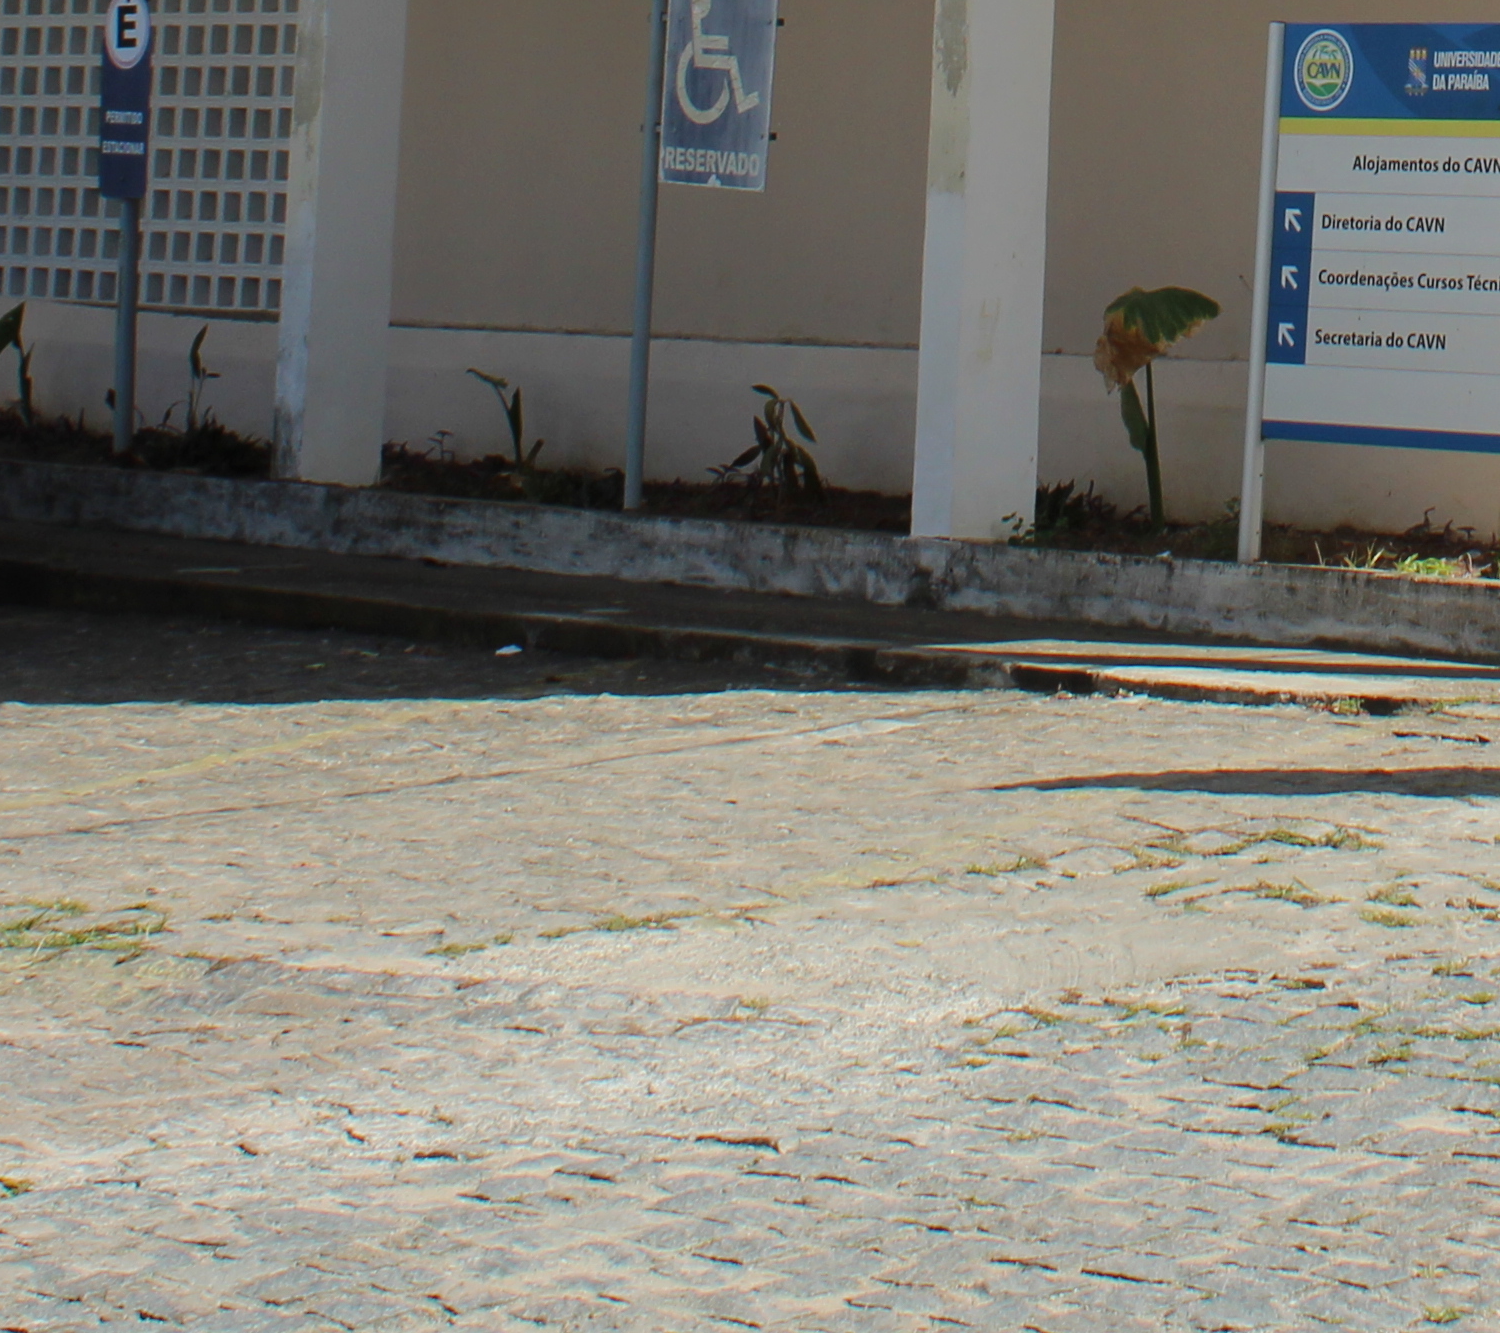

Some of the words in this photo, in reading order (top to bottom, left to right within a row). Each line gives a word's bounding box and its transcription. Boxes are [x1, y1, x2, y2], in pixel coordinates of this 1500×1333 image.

[116, 5, 138, 48] E
[1306, 61, 1341, 79] CAVN
[1432, 73, 1446, 91] DA
[1447, 69, 1490, 91] PARAÍBA
[105, 110, 143, 124] PERMITIDO
[102, 140, 145, 154] ESTACIONAR
[664, 146, 760, 176] RESERVADO
[1352, 154, 1439, 175] Alojamentos
[1442, 156, 1461, 173] do
[1321, 213, 1381, 231] Diretoria
[1385, 215, 1403, 232] do
[1406, 216, 1445, 233] CAVN
[1318, 269, 1414, 292] Coordenações
[1417, 273, 1464, 290] Cursos
[1315, 328, 1382, 347] Secretaria
[1385, 331, 1404, 348] do
[1407, 333, 1446, 350] CAVN
